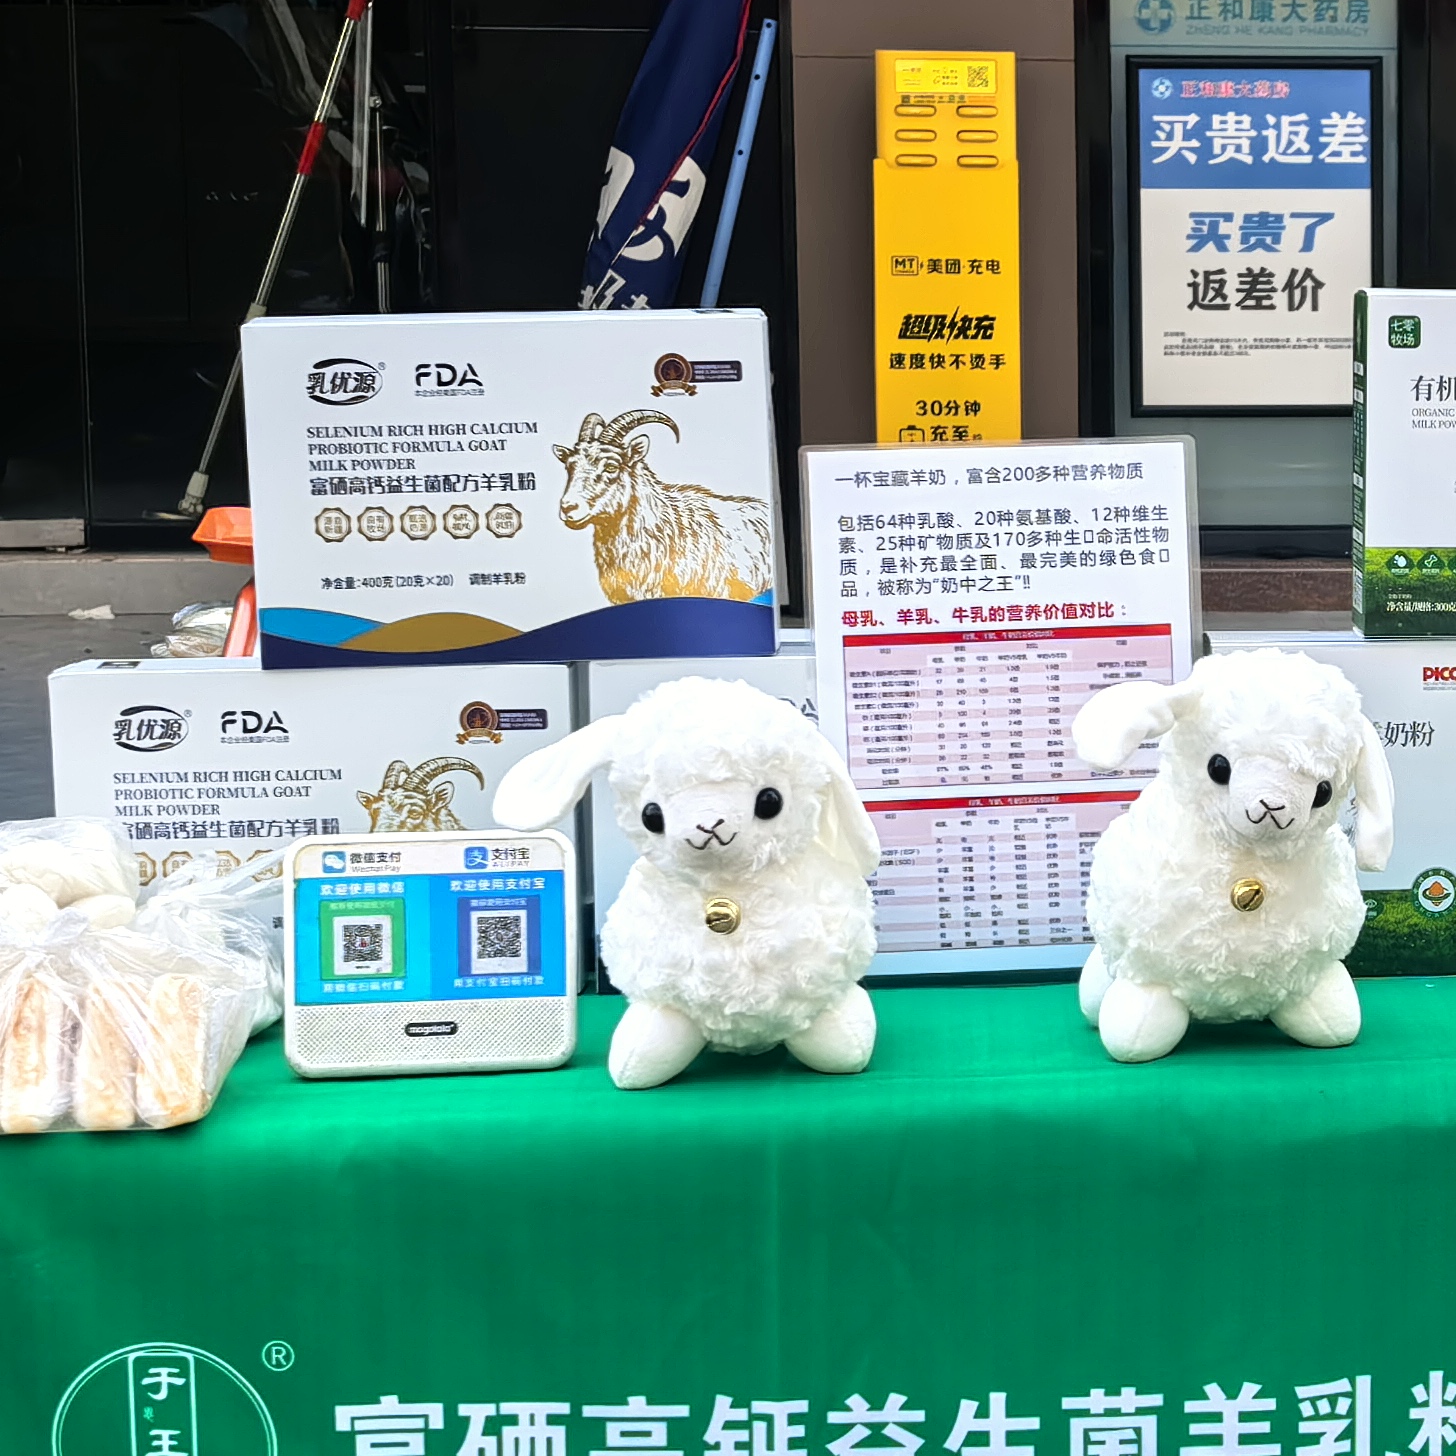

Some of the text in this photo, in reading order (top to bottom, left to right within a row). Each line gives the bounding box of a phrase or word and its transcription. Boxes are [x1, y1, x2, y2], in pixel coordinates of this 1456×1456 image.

[1151, 111, 1369, 165] 买贵返差
[1185, 211, 1335, 253] 买贵了
[927, 258, 961, 275] 美团
[968, 258, 1001, 275] 充电
[1186, 267, 1326, 312] 返差价
[898, 310, 996, 342] 超级快充
[889, 353, 1007, 371] 速度快不烫手
[415, 363, 484, 387] FDA
[915, 400, 982, 417] 30分钟
[307, 422, 538, 439] SELENIUM RICH HIGH CALCIUM
[308, 439, 507, 455] PROBIOTIC FORMULA GOAT
[309, 458, 416, 472] MILK POWDER
[310, 472, 537, 496] 富硒高钙益生菌配方羊乳粉
[221, 710, 289, 734] FDA
[113, 769, 342, 785] SELENIUM RICH HIGH CALCIUM
[114, 786, 311, 801] PROBIOTIC FORMULA GOAT
[115, 804, 220, 817] MILK POWDER
[349, 847, 530, 864] 微信支付 支付宝
[320, 878, 545, 895] 欢迎使用微信 欢迎使用支付宝
